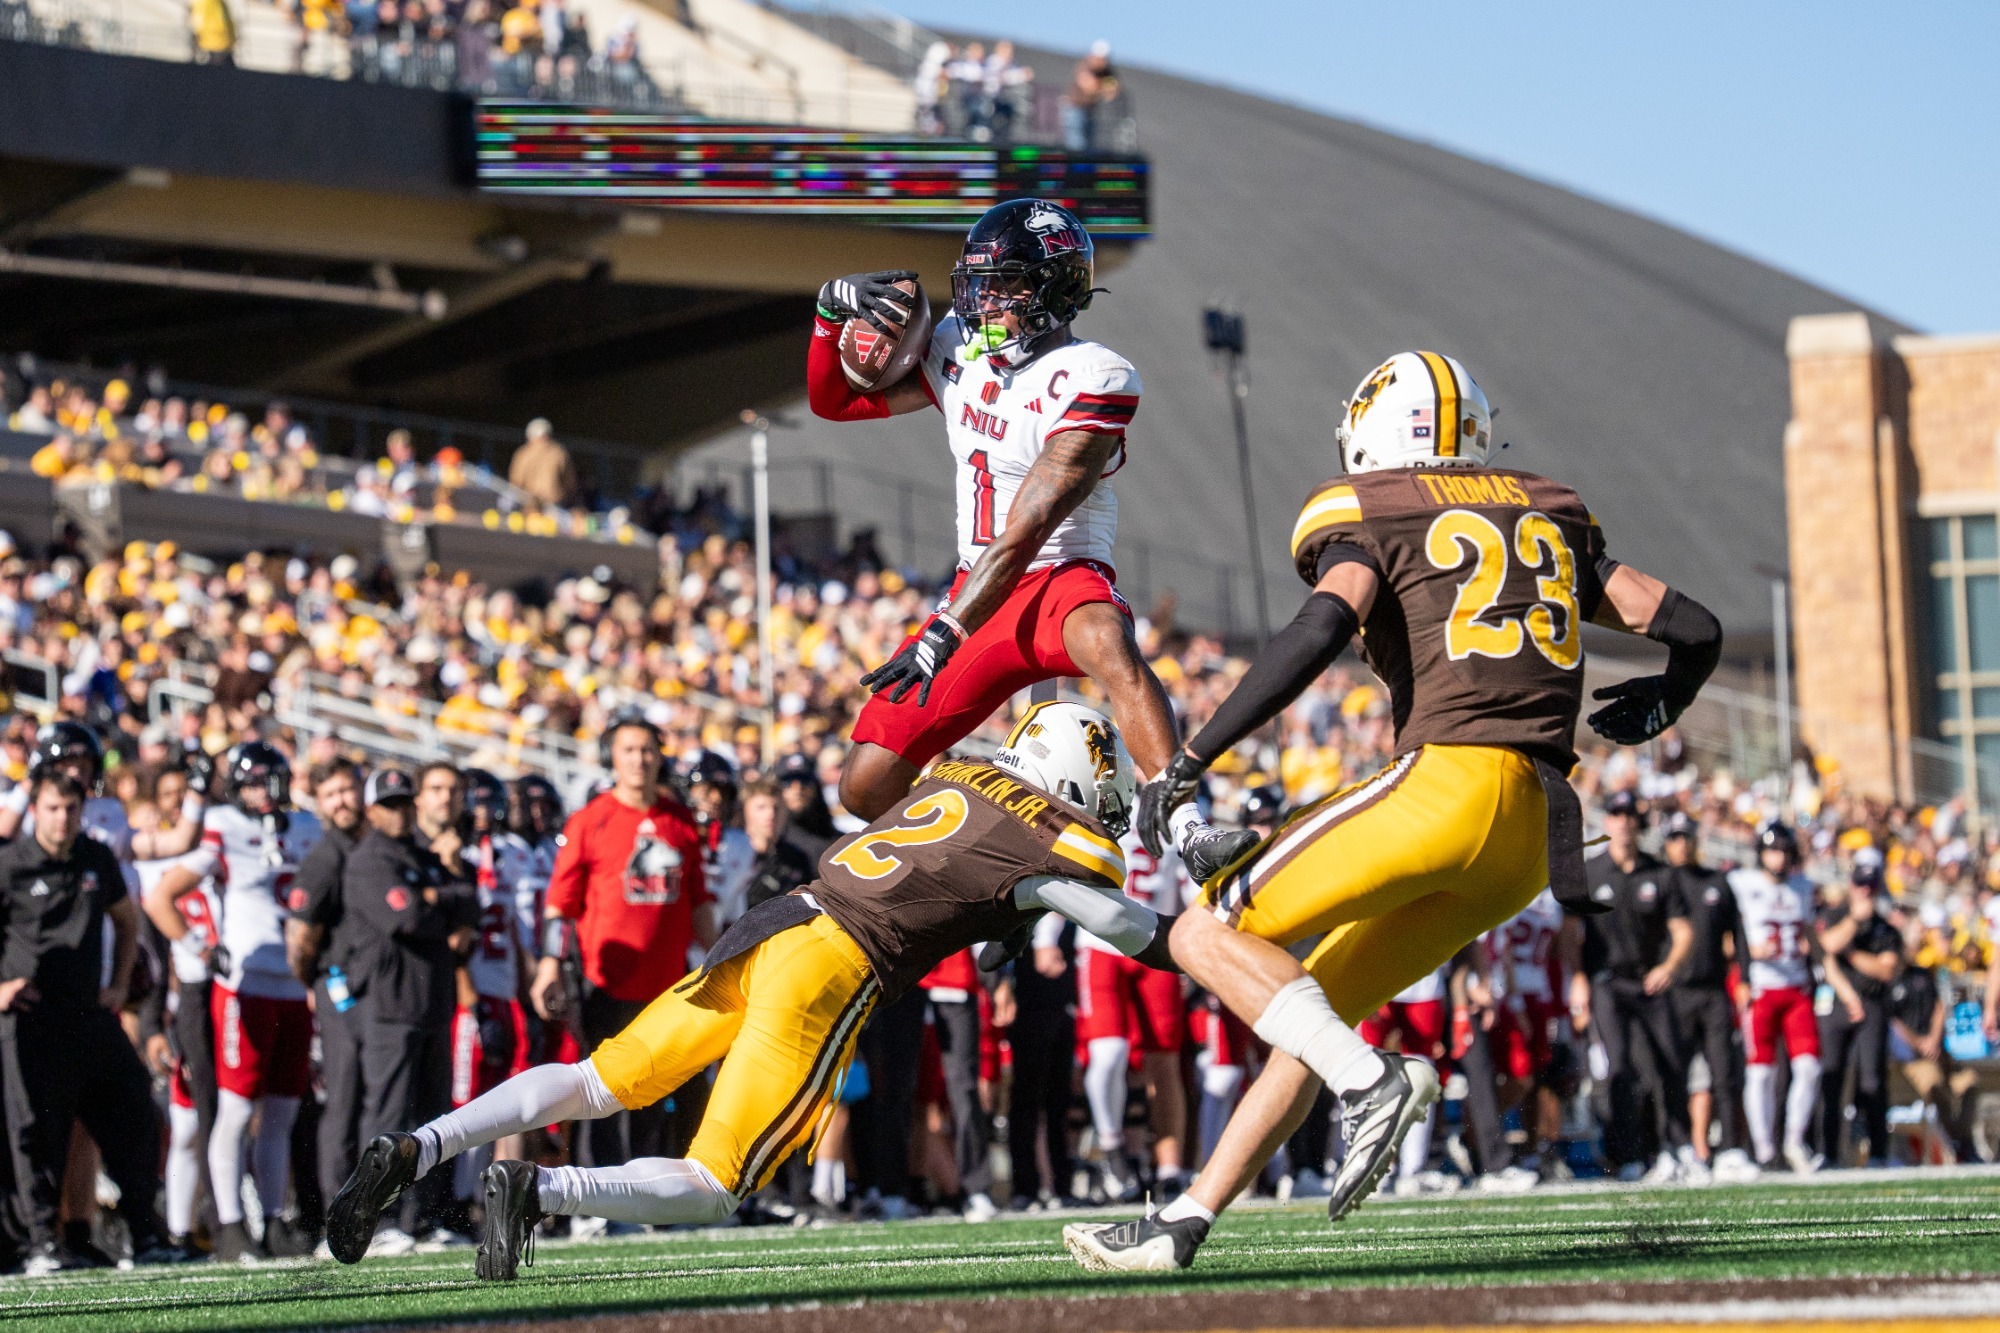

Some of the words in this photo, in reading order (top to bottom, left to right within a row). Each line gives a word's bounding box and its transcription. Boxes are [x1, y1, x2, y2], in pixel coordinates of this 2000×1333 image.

[966, 254, 986, 265] NIU
[1041, 230, 1086, 256] NIU
[1047, 369, 1070, 401] C
[960, 403, 1009, 442] NIU
[968, 448, 997, 546] 1
[1417, 474, 1530, 507] THOMAS
[1426, 509, 1582, 670] 23
[1005, 794, 1049, 829] JR.
[829, 788, 969, 880] 2
